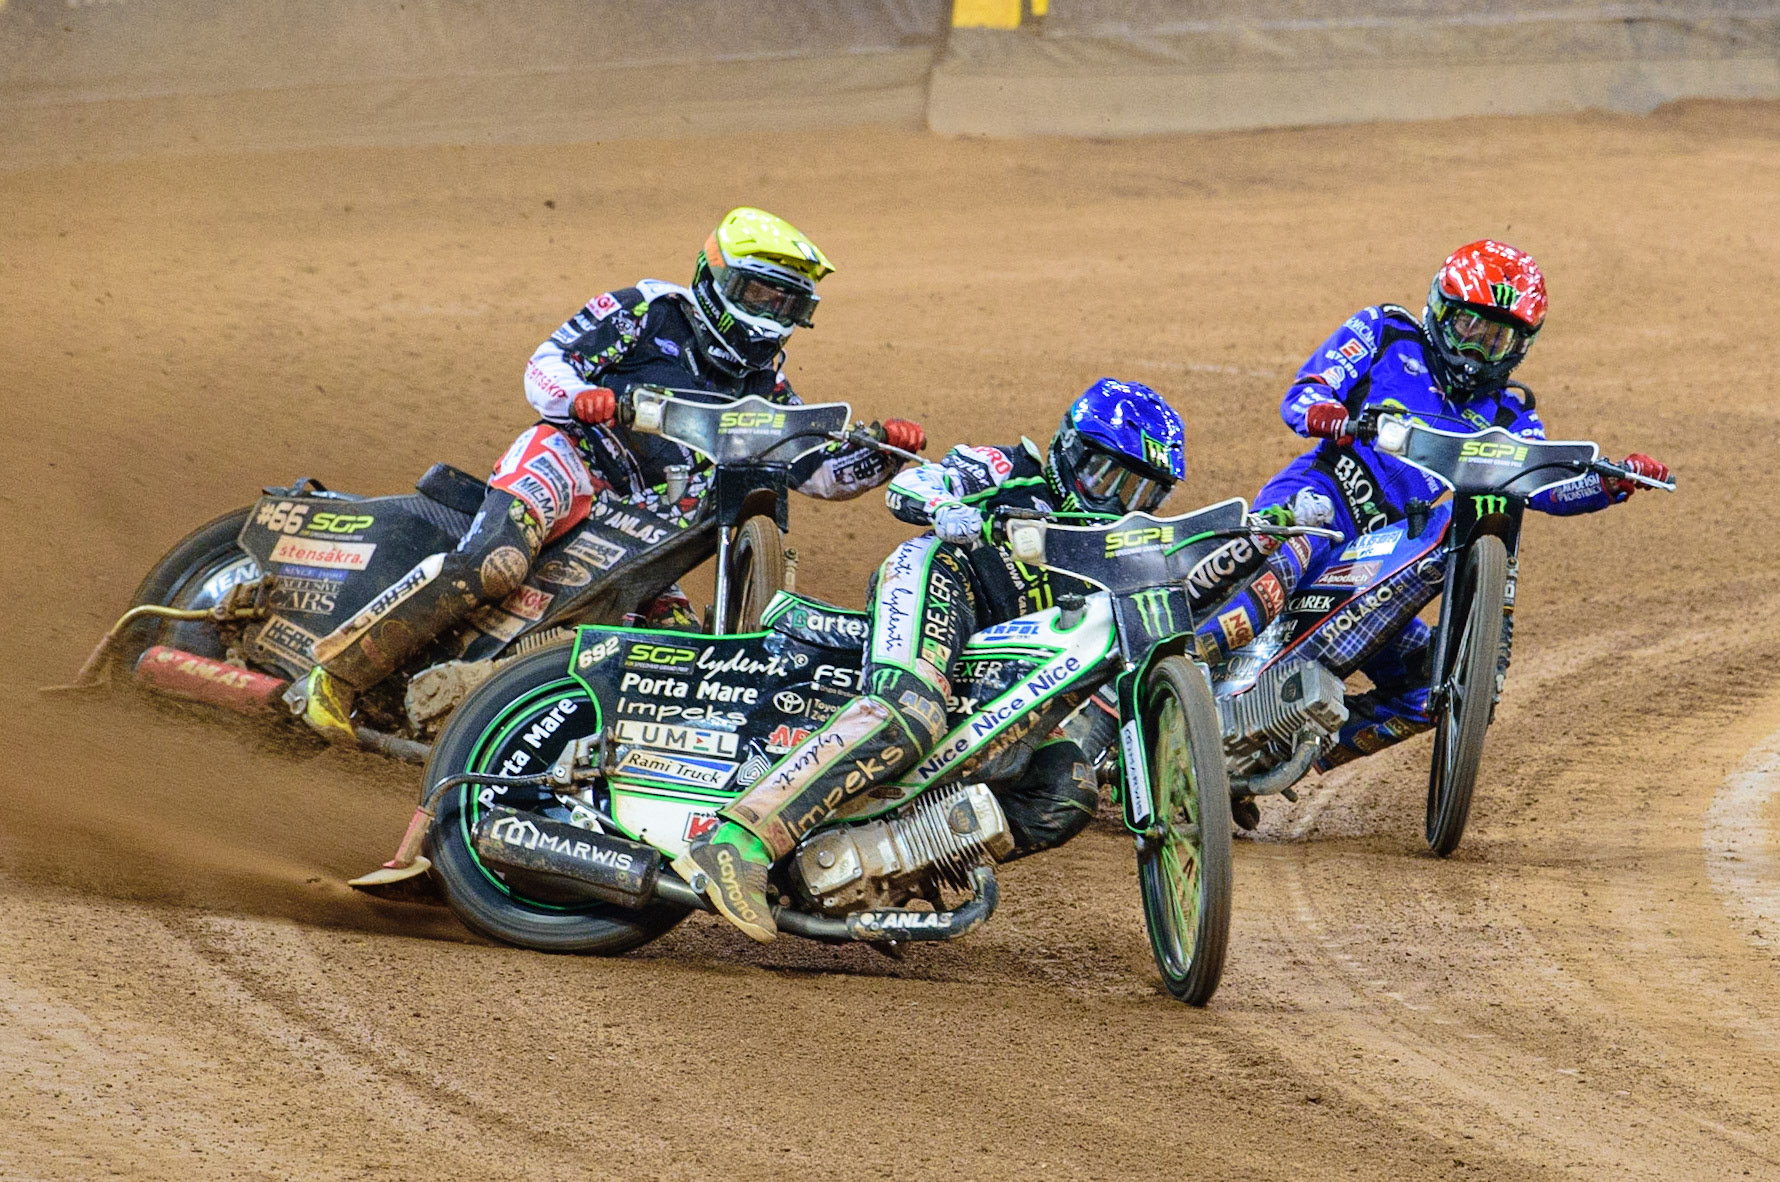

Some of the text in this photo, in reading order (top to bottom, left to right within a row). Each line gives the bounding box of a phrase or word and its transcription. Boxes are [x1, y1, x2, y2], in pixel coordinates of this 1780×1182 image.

[257, 501, 309, 534] #66
[306, 512, 375, 533] SGP
[604, 511, 667, 544] ANLAS
[628, 644, 696, 665] SGP
[620, 672, 759, 705] Porta Mare
[523, 697, 579, 749] Mare
[616, 698, 748, 726] Impeks
[918, 656, 1081, 780] Nice Nice Nice
[628, 752, 723, 785] Rami Truck
[787, 745, 905, 839] Impeks
[539, 832, 634, 871] MARWIS
[879, 912, 954, 929] ANLAS
